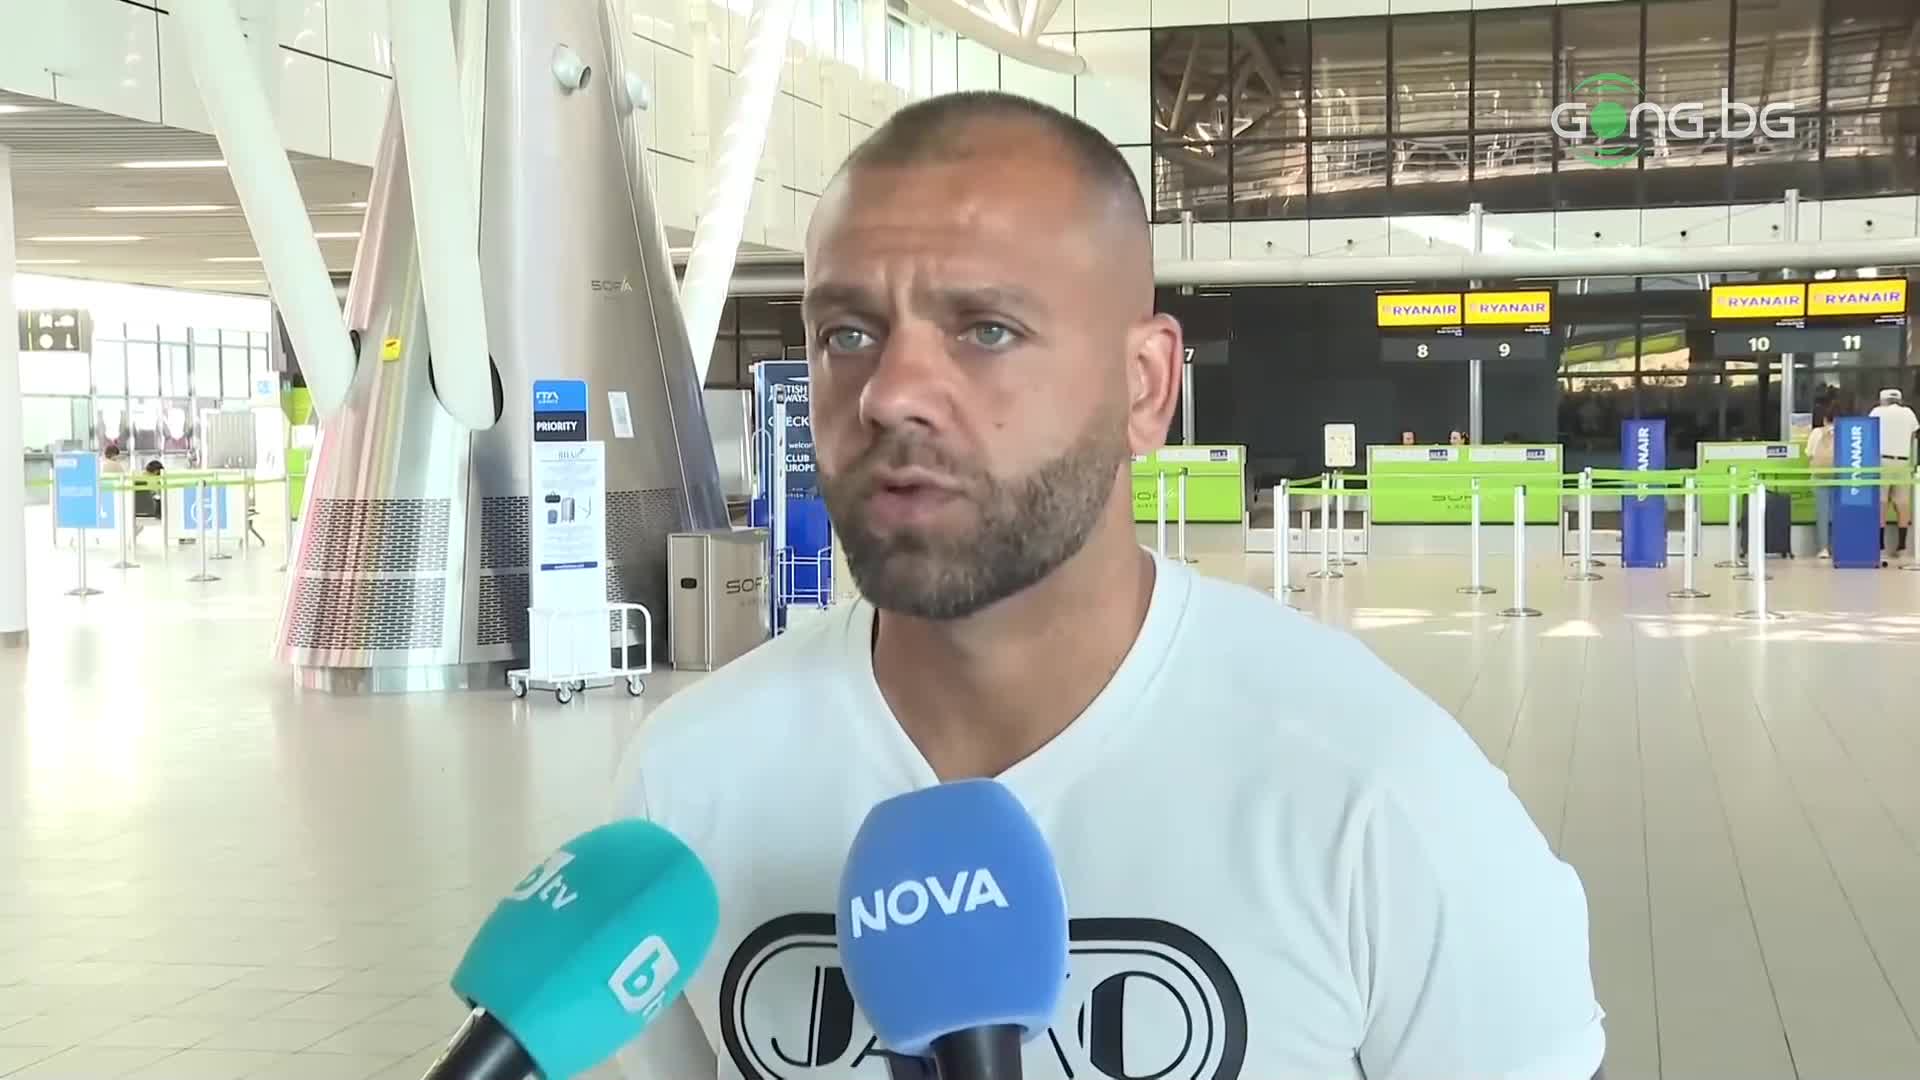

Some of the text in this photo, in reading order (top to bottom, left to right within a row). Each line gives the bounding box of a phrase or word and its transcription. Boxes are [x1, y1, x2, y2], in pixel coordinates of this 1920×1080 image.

[1728, 296, 1800, 307] RYANAIR
[1825, 292, 1901, 304] RYANAIR
[1393, 305, 1457, 315] RYANAIR
[1480, 303, 1546, 313] RYANAIR
[1749, 337, 1770, 351] 10
[1842, 335, 1861, 350] 11
[1184, 347, 1195, 362] 7
[1417, 344, 1429, 358] 8
[1499, 343, 1511, 358] 9
[536, 421, 578, 432] PRIORITY
[767, 416, 810, 427] CECK
[785, 454, 810, 463] CLUB
[1638, 427, 1649, 490] ANAIR
[1851, 425, 1862, 487] ANAIR
[785, 464, 816, 472] UROPE
[850, 868, 1009, 939] NOVA
